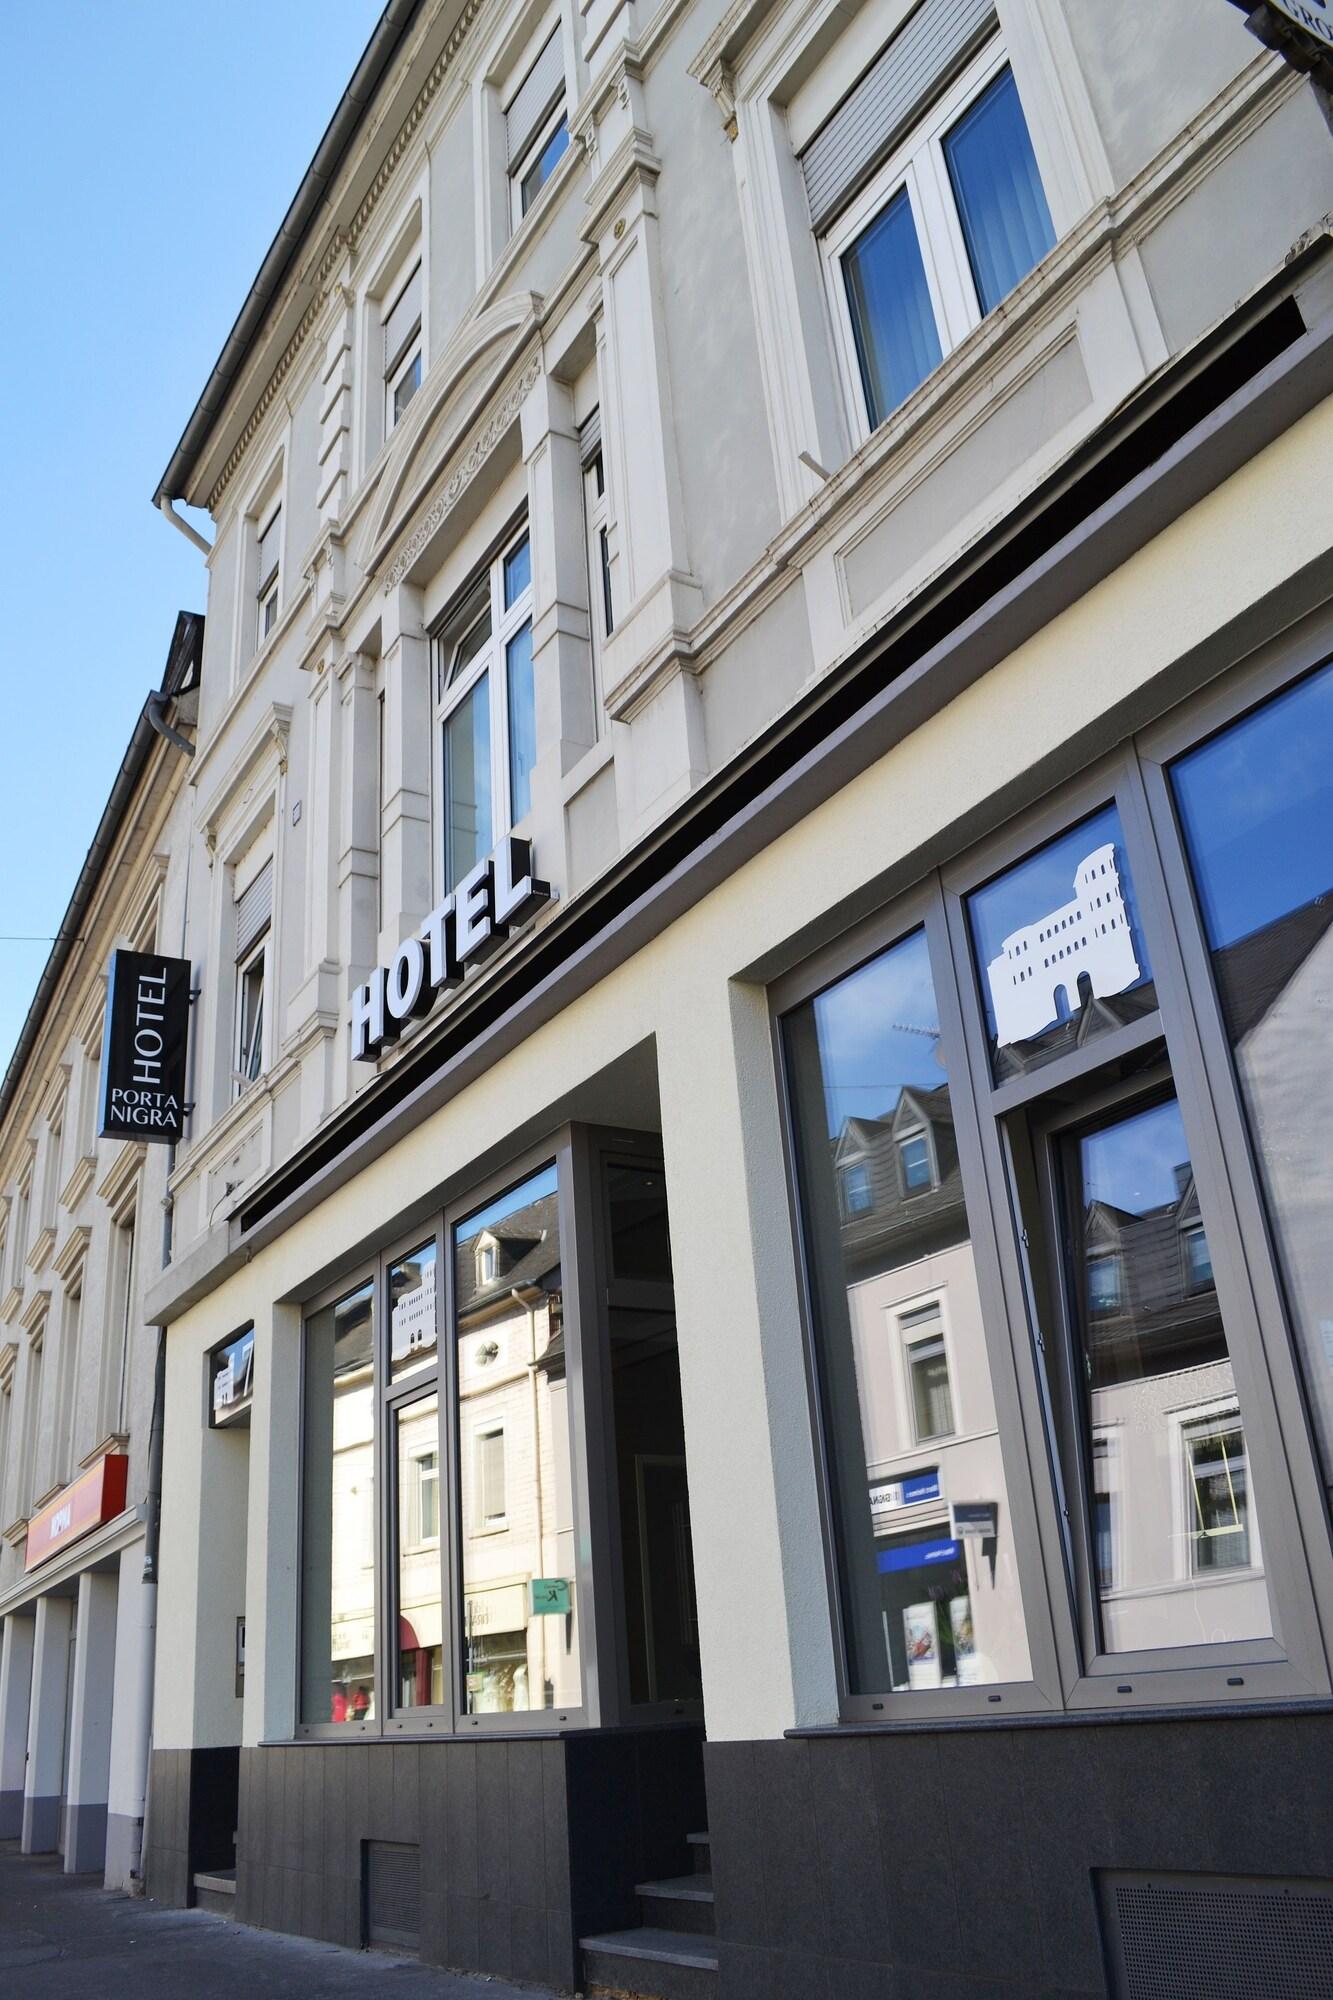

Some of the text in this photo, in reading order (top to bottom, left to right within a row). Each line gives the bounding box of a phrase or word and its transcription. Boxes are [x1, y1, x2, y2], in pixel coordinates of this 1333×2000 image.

[352, 836, 538, 1062] HOTEL
[132, 967, 167, 1084] HOTEL
[110, 1105, 177, 1128] NIGRA
[112, 1088, 178, 1109] PORTA
